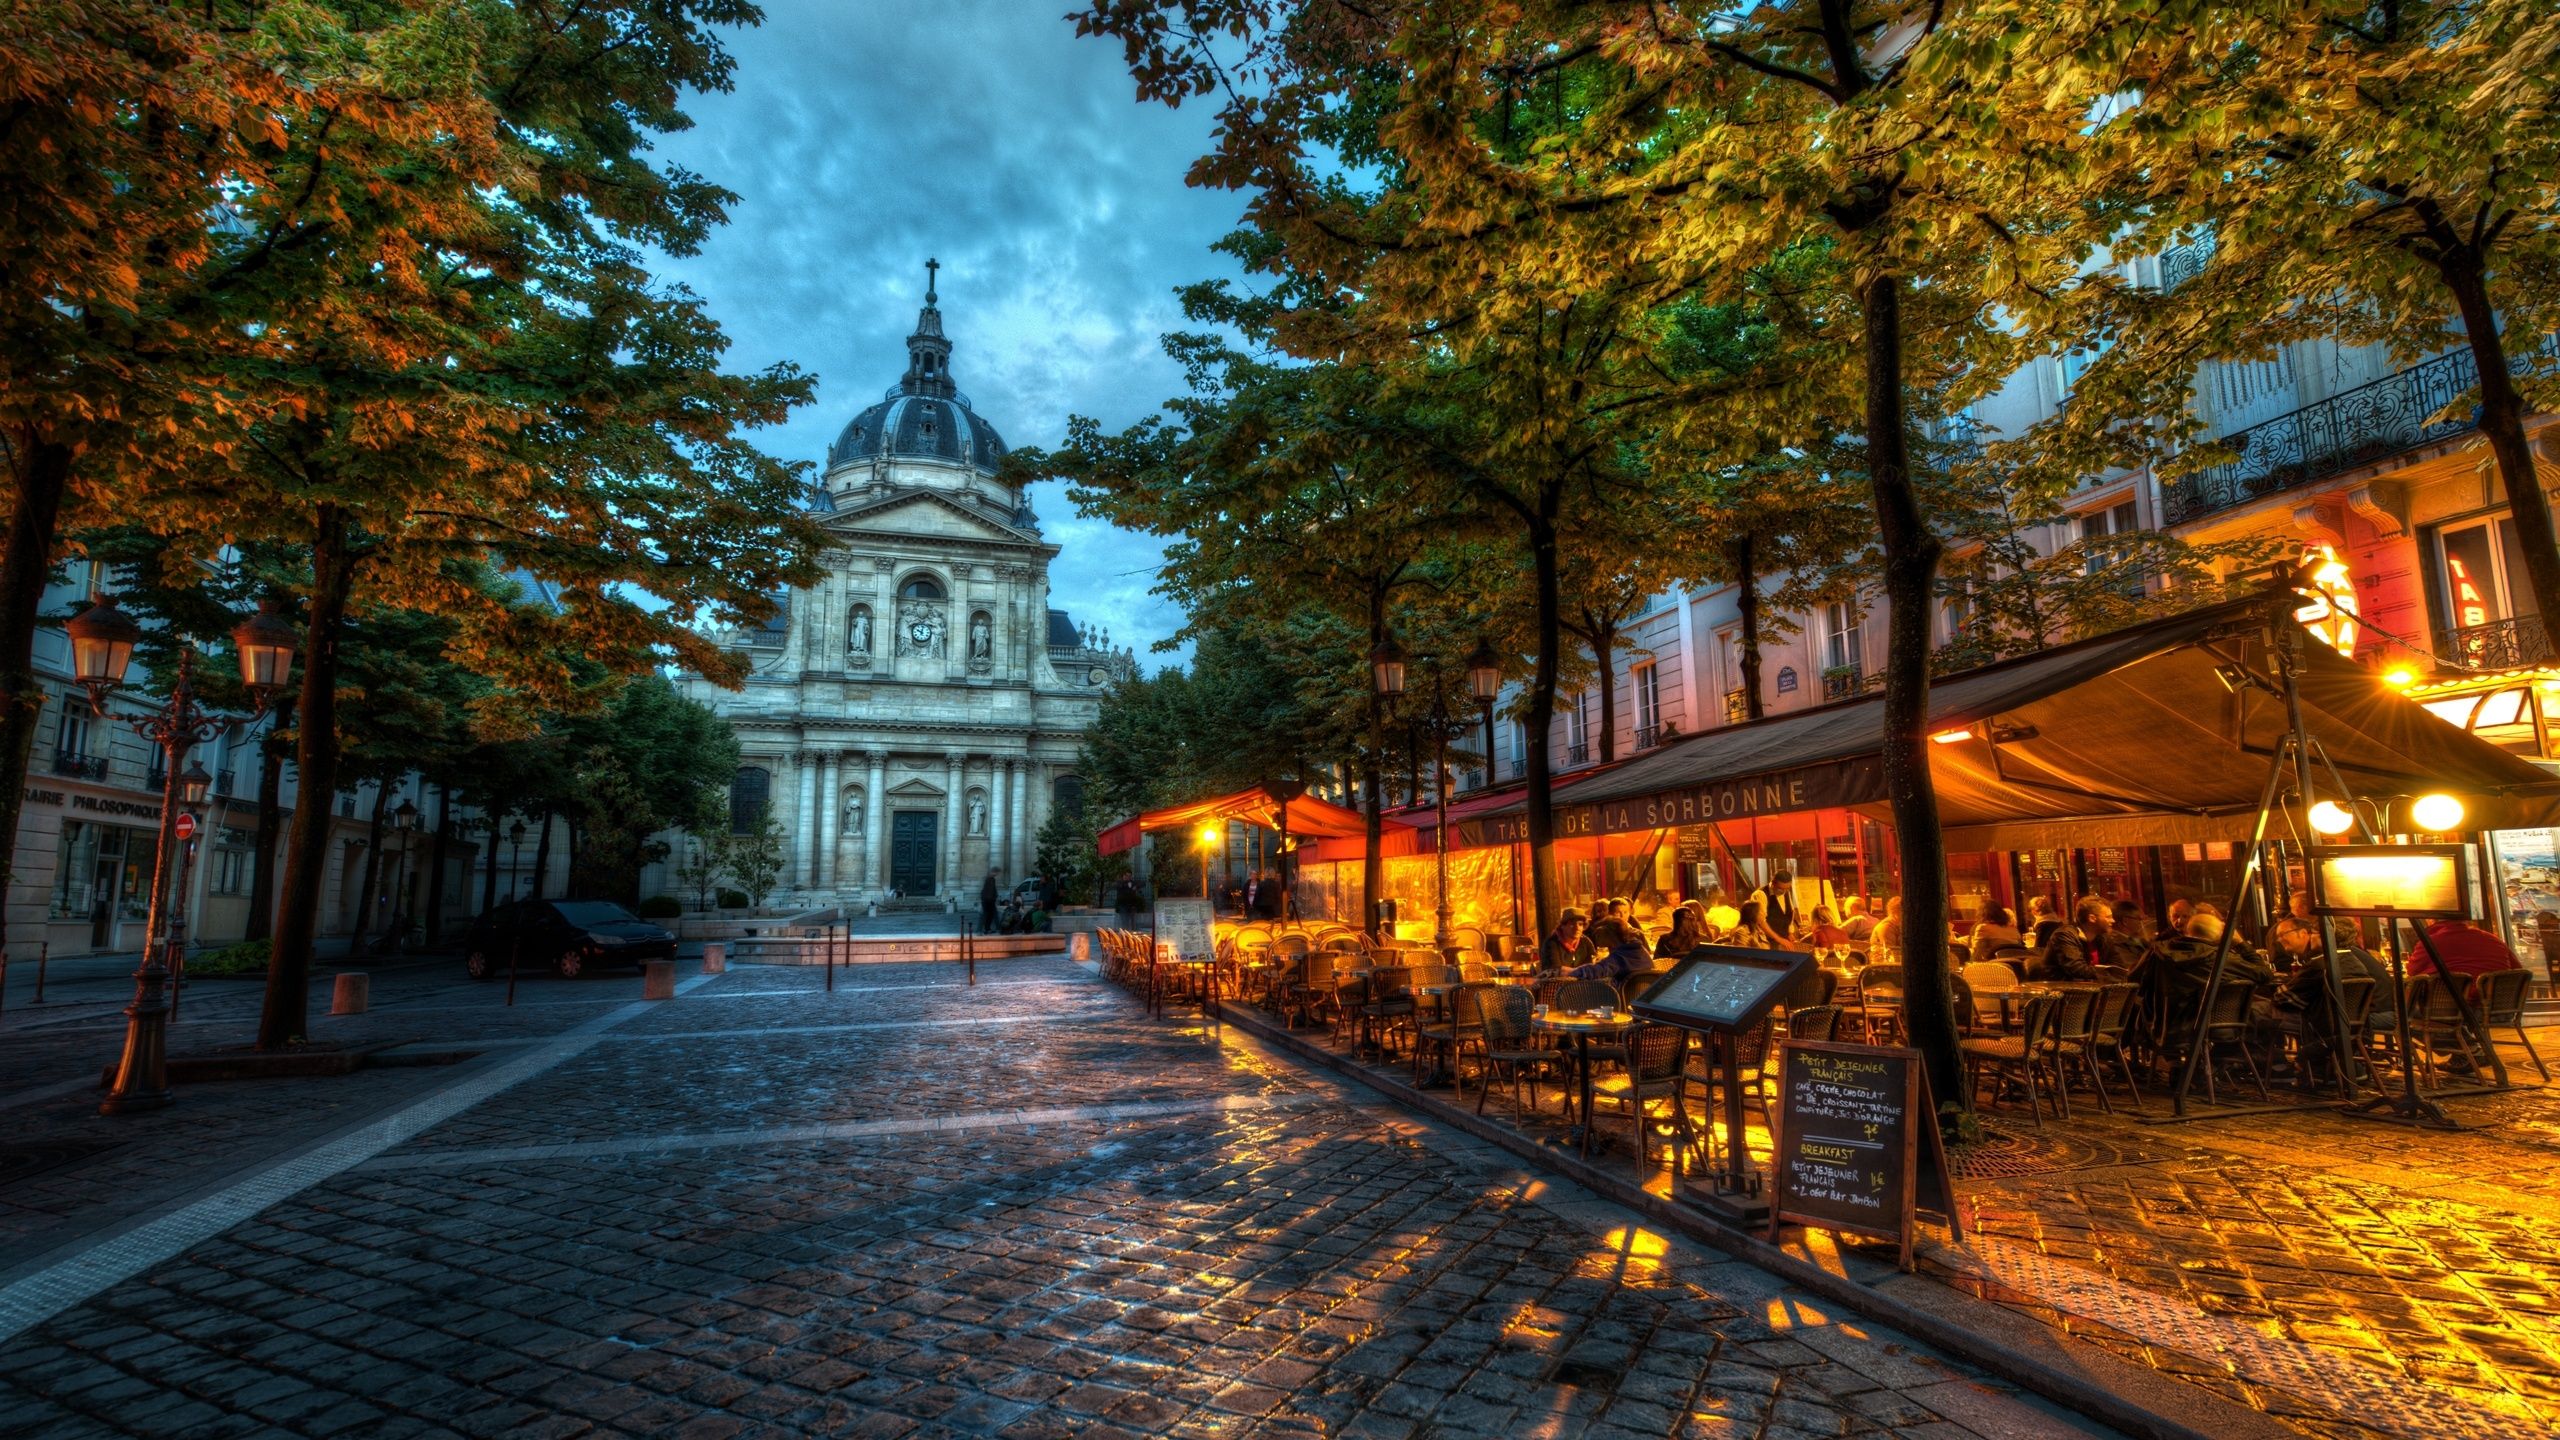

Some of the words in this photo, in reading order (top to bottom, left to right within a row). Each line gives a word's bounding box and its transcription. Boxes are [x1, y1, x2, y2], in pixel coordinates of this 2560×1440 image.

[1499, 821, 1529, 840] TAB
[1567, 814, 1590, 833] DE
[1606, 808, 1630, 830] LA
[1646, 780, 1805, 825] SORBONNE
[1798, 1053, 1827, 1066] PETIT
[1834, 1058, 1887, 1075] DEJEUNER
[1810, 1068, 1853, 1082] FRANÇAIS
[1800, 1144, 1855, 1159] BREAKFAST
